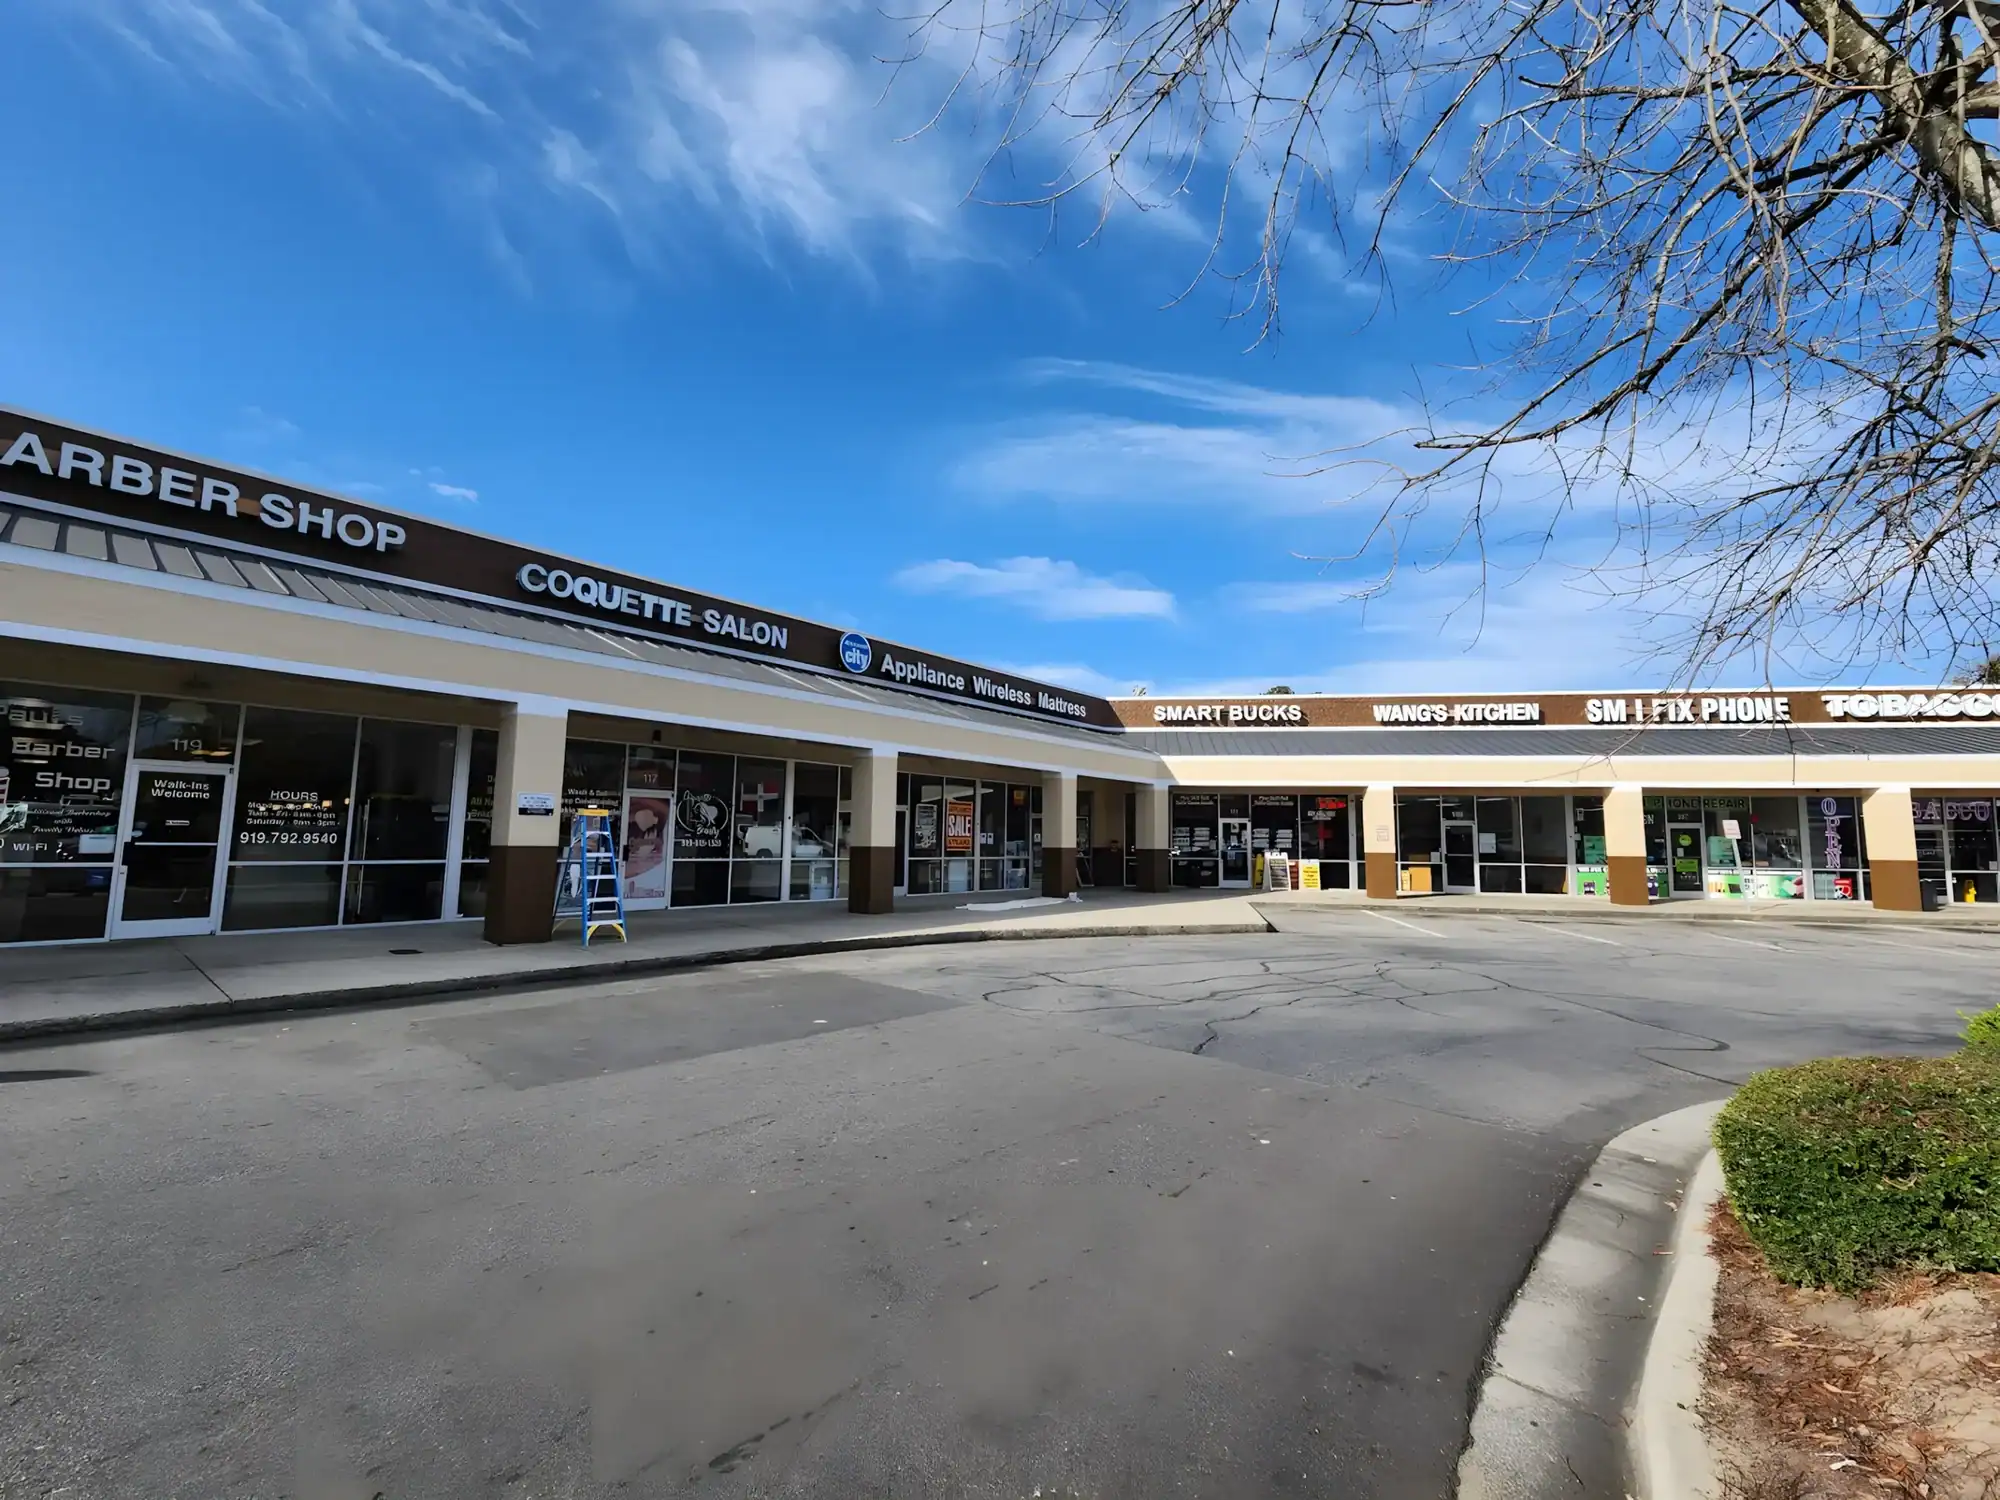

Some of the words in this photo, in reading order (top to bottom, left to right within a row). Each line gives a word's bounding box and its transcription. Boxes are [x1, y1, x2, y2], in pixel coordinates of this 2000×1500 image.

[259, 493, 407, 553] SHOP
[516, 563, 693, 627] COQUETTE
[702, 608, 788, 650] SALON
[845, 647, 868, 669] city
[881, 653, 965, 690] Appliance
[973, 675, 1031, 706] Wireless
[1038, 691, 1087, 718] Mattress
[1153, 705, 1224, 721] SMART
[1229, 704, 1302, 721] BUCKS
[1372, 703, 1448, 722] WANG'S
[1454, 703, 1540, 721] KITCHEN
[1584, 699, 1627, 723] SM
[1652, 698, 1695, 722] FIX
[1701, 697, 1790, 722] PHONE
[12, 737, 116, 760] Barber
[35, 772, 111, 793] Shop
[154, 780, 210, 791] Walk-Ins
[151, 788, 210, 800] Welcome
[270, 790, 318, 801] HOURS
[1703, 798, 1745, 809] REPAIR
[948, 815, 971, 837] SALE
[1821, 797, 1842, 869] OPEN
[13, 842, 48, 851] WI-FI
[240, 831, 338, 844] 919.792.9540
